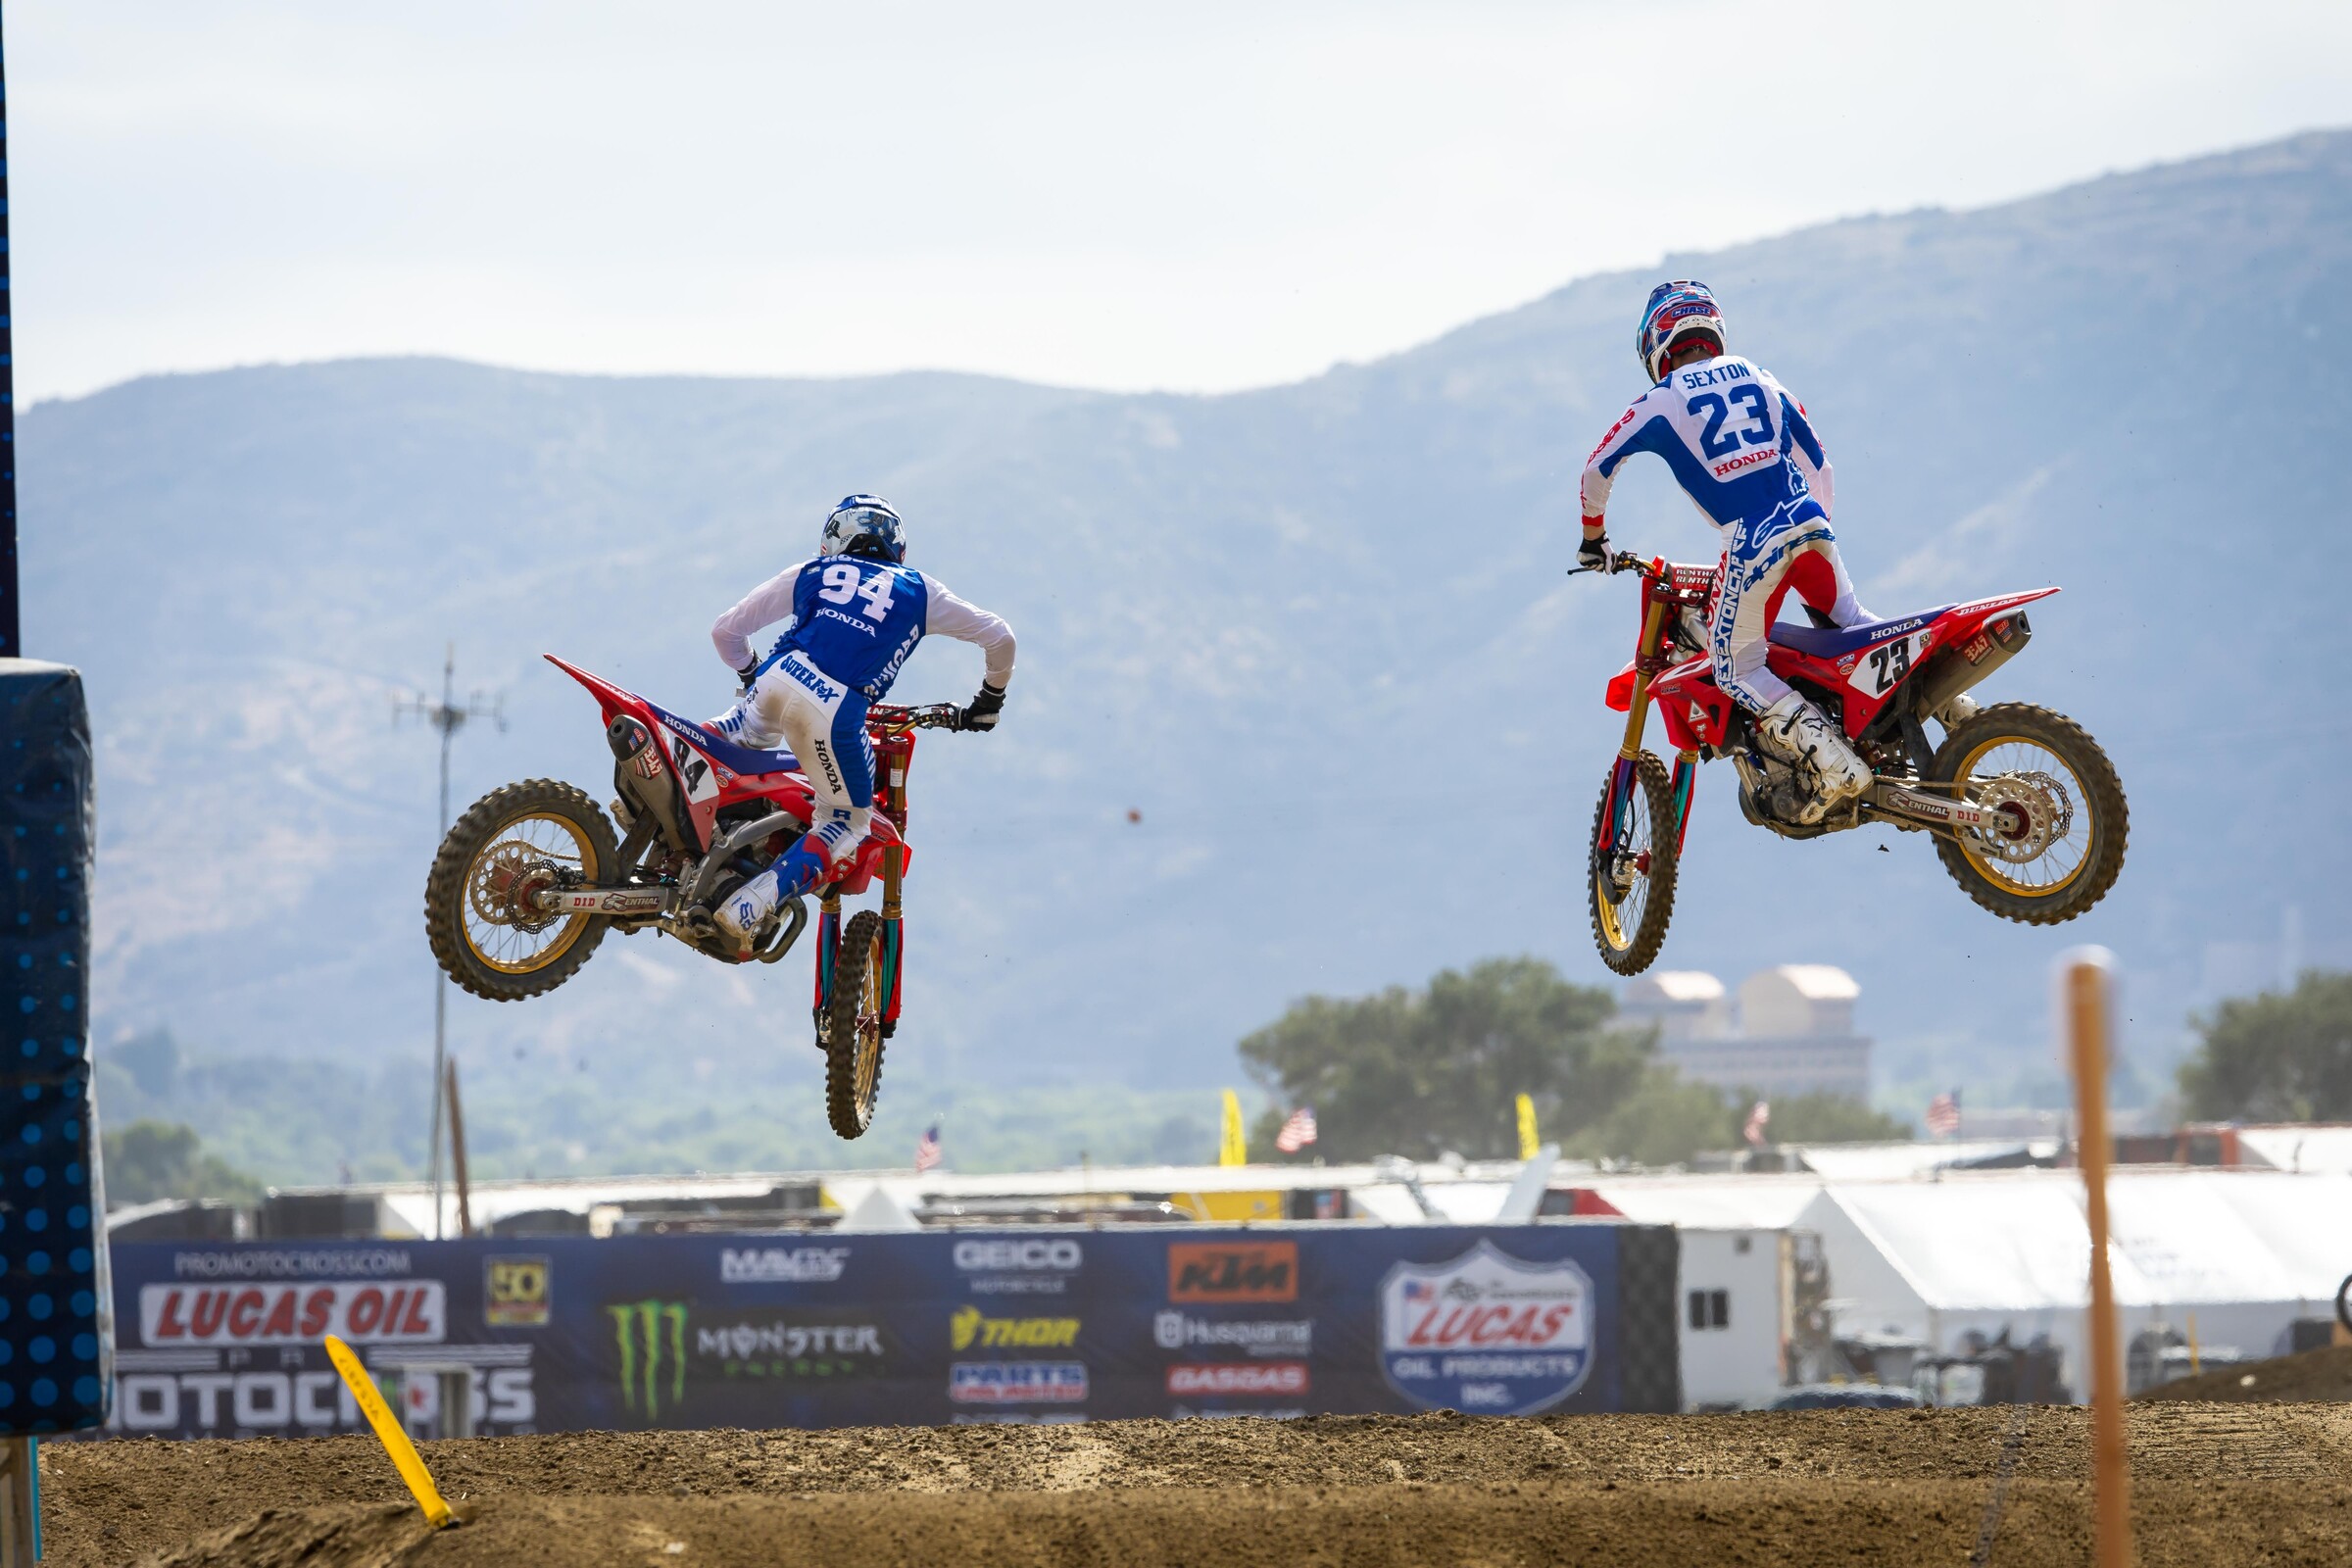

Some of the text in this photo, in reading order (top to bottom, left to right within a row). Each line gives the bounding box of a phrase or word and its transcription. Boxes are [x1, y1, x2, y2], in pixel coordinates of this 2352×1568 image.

[1672, 306, 1711, 318] CHASE
[1683, 362, 1750, 390] SEXTON
[1687, 383, 1775, 462] 23
[1714, 449, 1778, 476] HONDA
[818, 564, 896, 623] 94
[815, 608, 876, 638] HONDA
[1870, 618, 1924, 640] HONDA
[1870, 637, 1911, 695] 23
[663, 713, 708, 746] HONDA
[673, 736, 710, 796] 94
[814, 739, 842, 795] HONDA
[954, 1240, 1082, 1270] GEICO
[1178, 1248, 1290, 1292] KTM
[158, 1287, 431, 1338] LUCAS OIL
[1406, 1304, 1574, 1347] LUCAS
[697, 1322, 883, 1359] MONSTER
[981, 1318, 1080, 1347] THOR
[1169, 1366, 1306, 1391] GASGAS
[1393, 1355, 1578, 1379] OIL PRODUCTS
